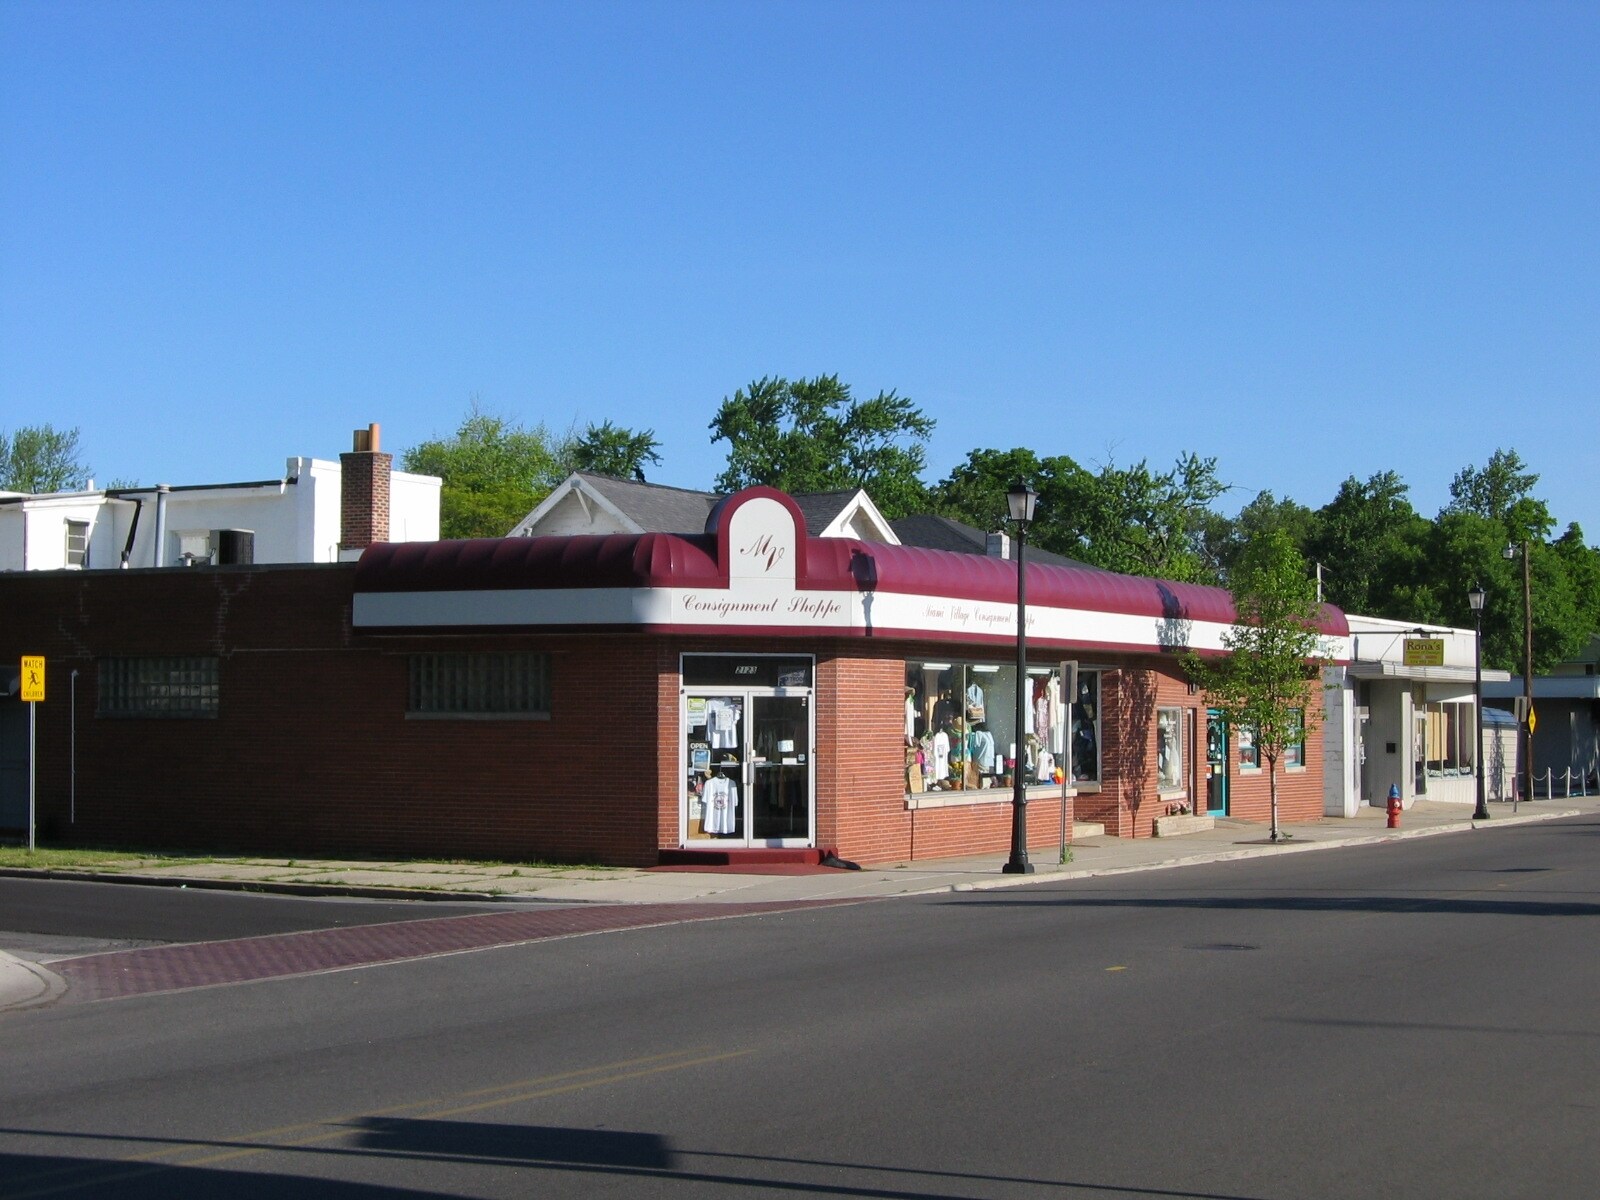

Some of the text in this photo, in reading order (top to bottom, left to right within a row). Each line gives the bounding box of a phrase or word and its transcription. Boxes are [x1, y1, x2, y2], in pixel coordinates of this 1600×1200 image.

[682, 594, 843, 619] Consignment Shoppe
[1407, 641, 1441, 651] Rona's
[23, 659, 43, 668] WATCH
